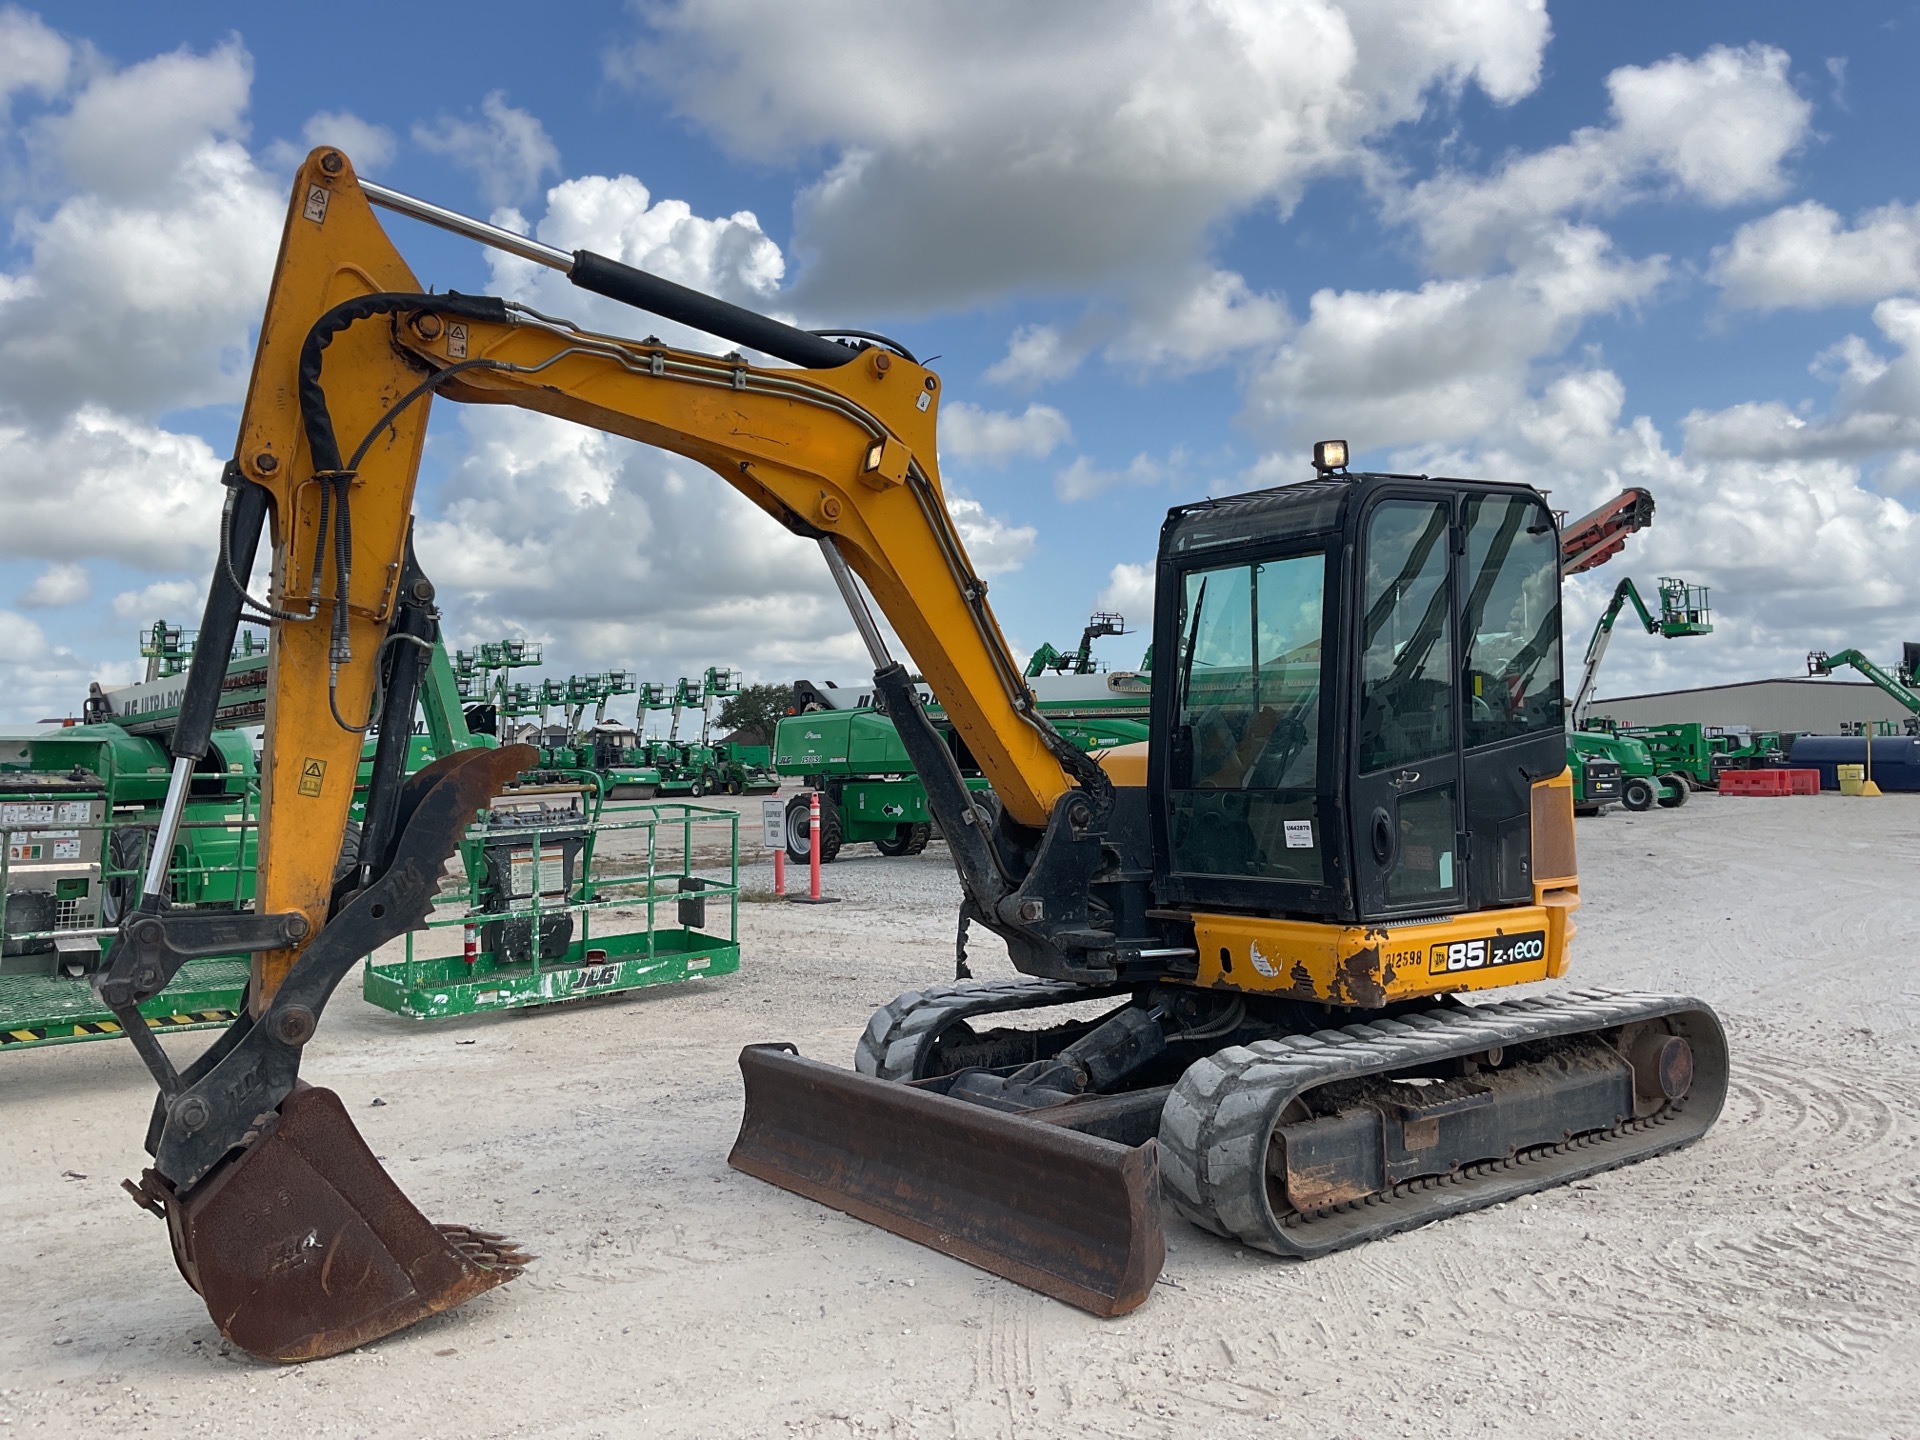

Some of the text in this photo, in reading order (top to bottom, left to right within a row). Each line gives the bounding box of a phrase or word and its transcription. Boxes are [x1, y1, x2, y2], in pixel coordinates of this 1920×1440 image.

[779, 756, 792, 764] JLG
[1447, 940, 1485, 971] 85
[572, 965, 616, 989] JLG
